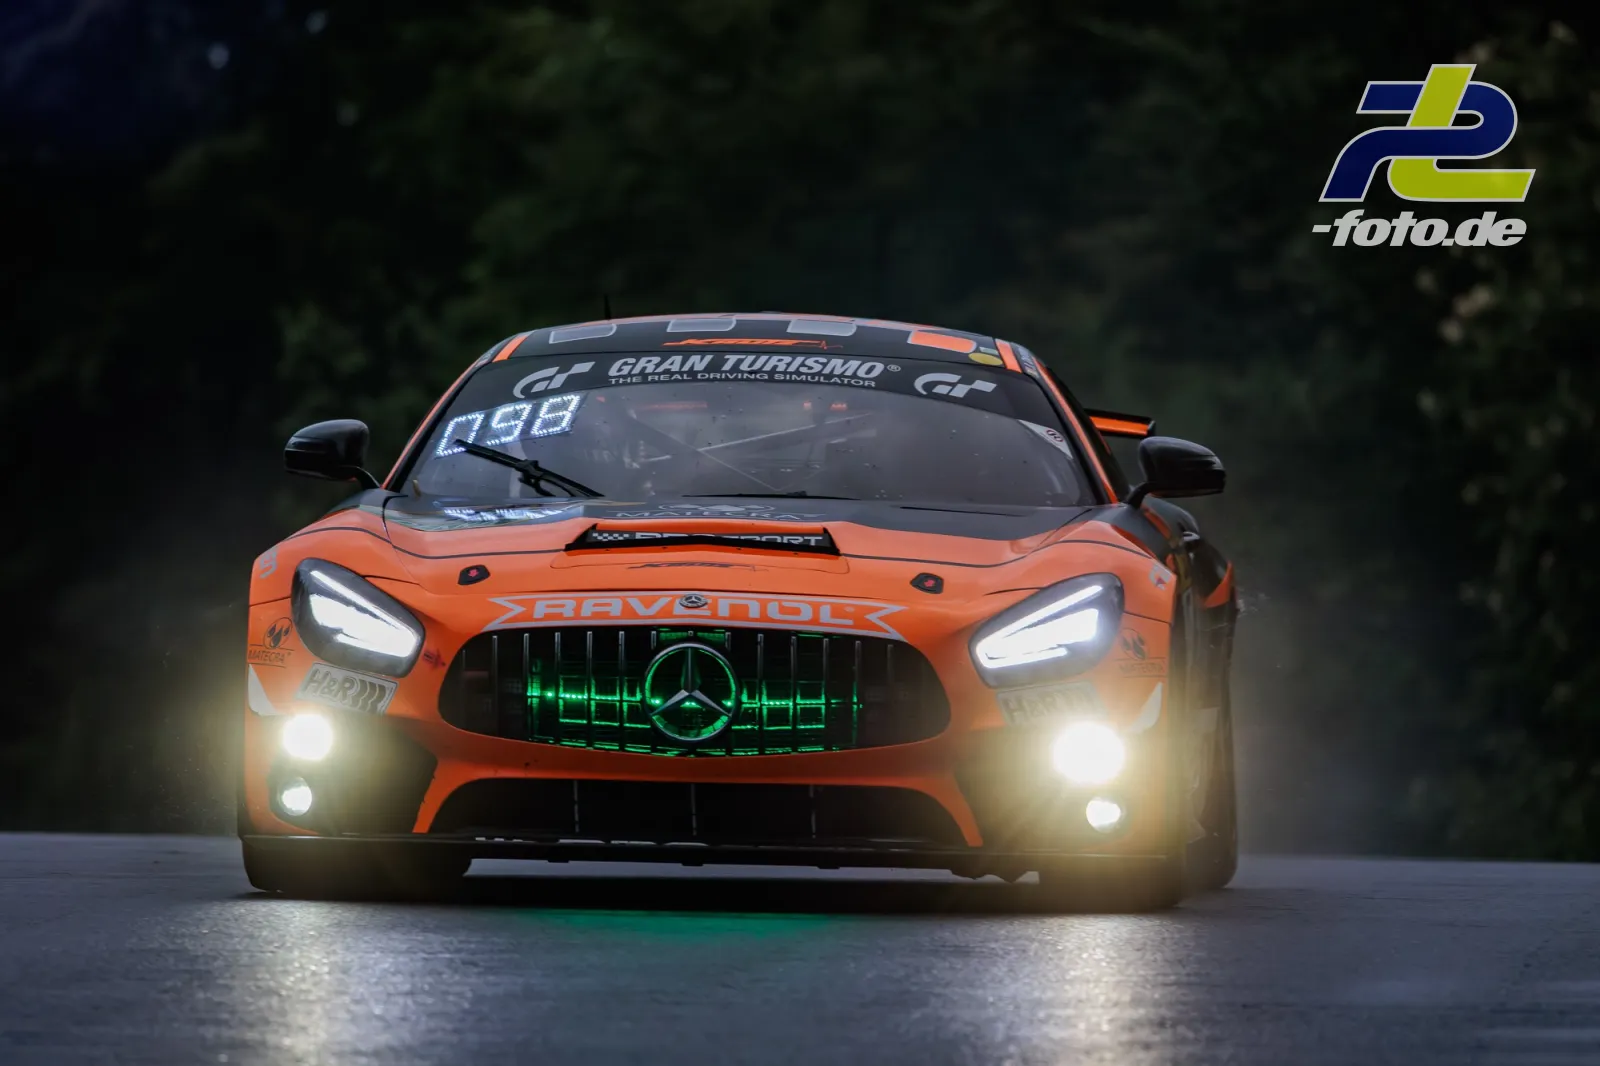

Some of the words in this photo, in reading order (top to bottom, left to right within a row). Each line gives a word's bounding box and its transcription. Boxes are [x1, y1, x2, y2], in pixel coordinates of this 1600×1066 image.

[608, 354, 714, 377] GRAN
[608, 375, 642, 385] THE
[647, 374, 693, 382] REAL
[697, 372, 769, 381] DRIVING
[773, 373, 876, 388] SIMULATOR
